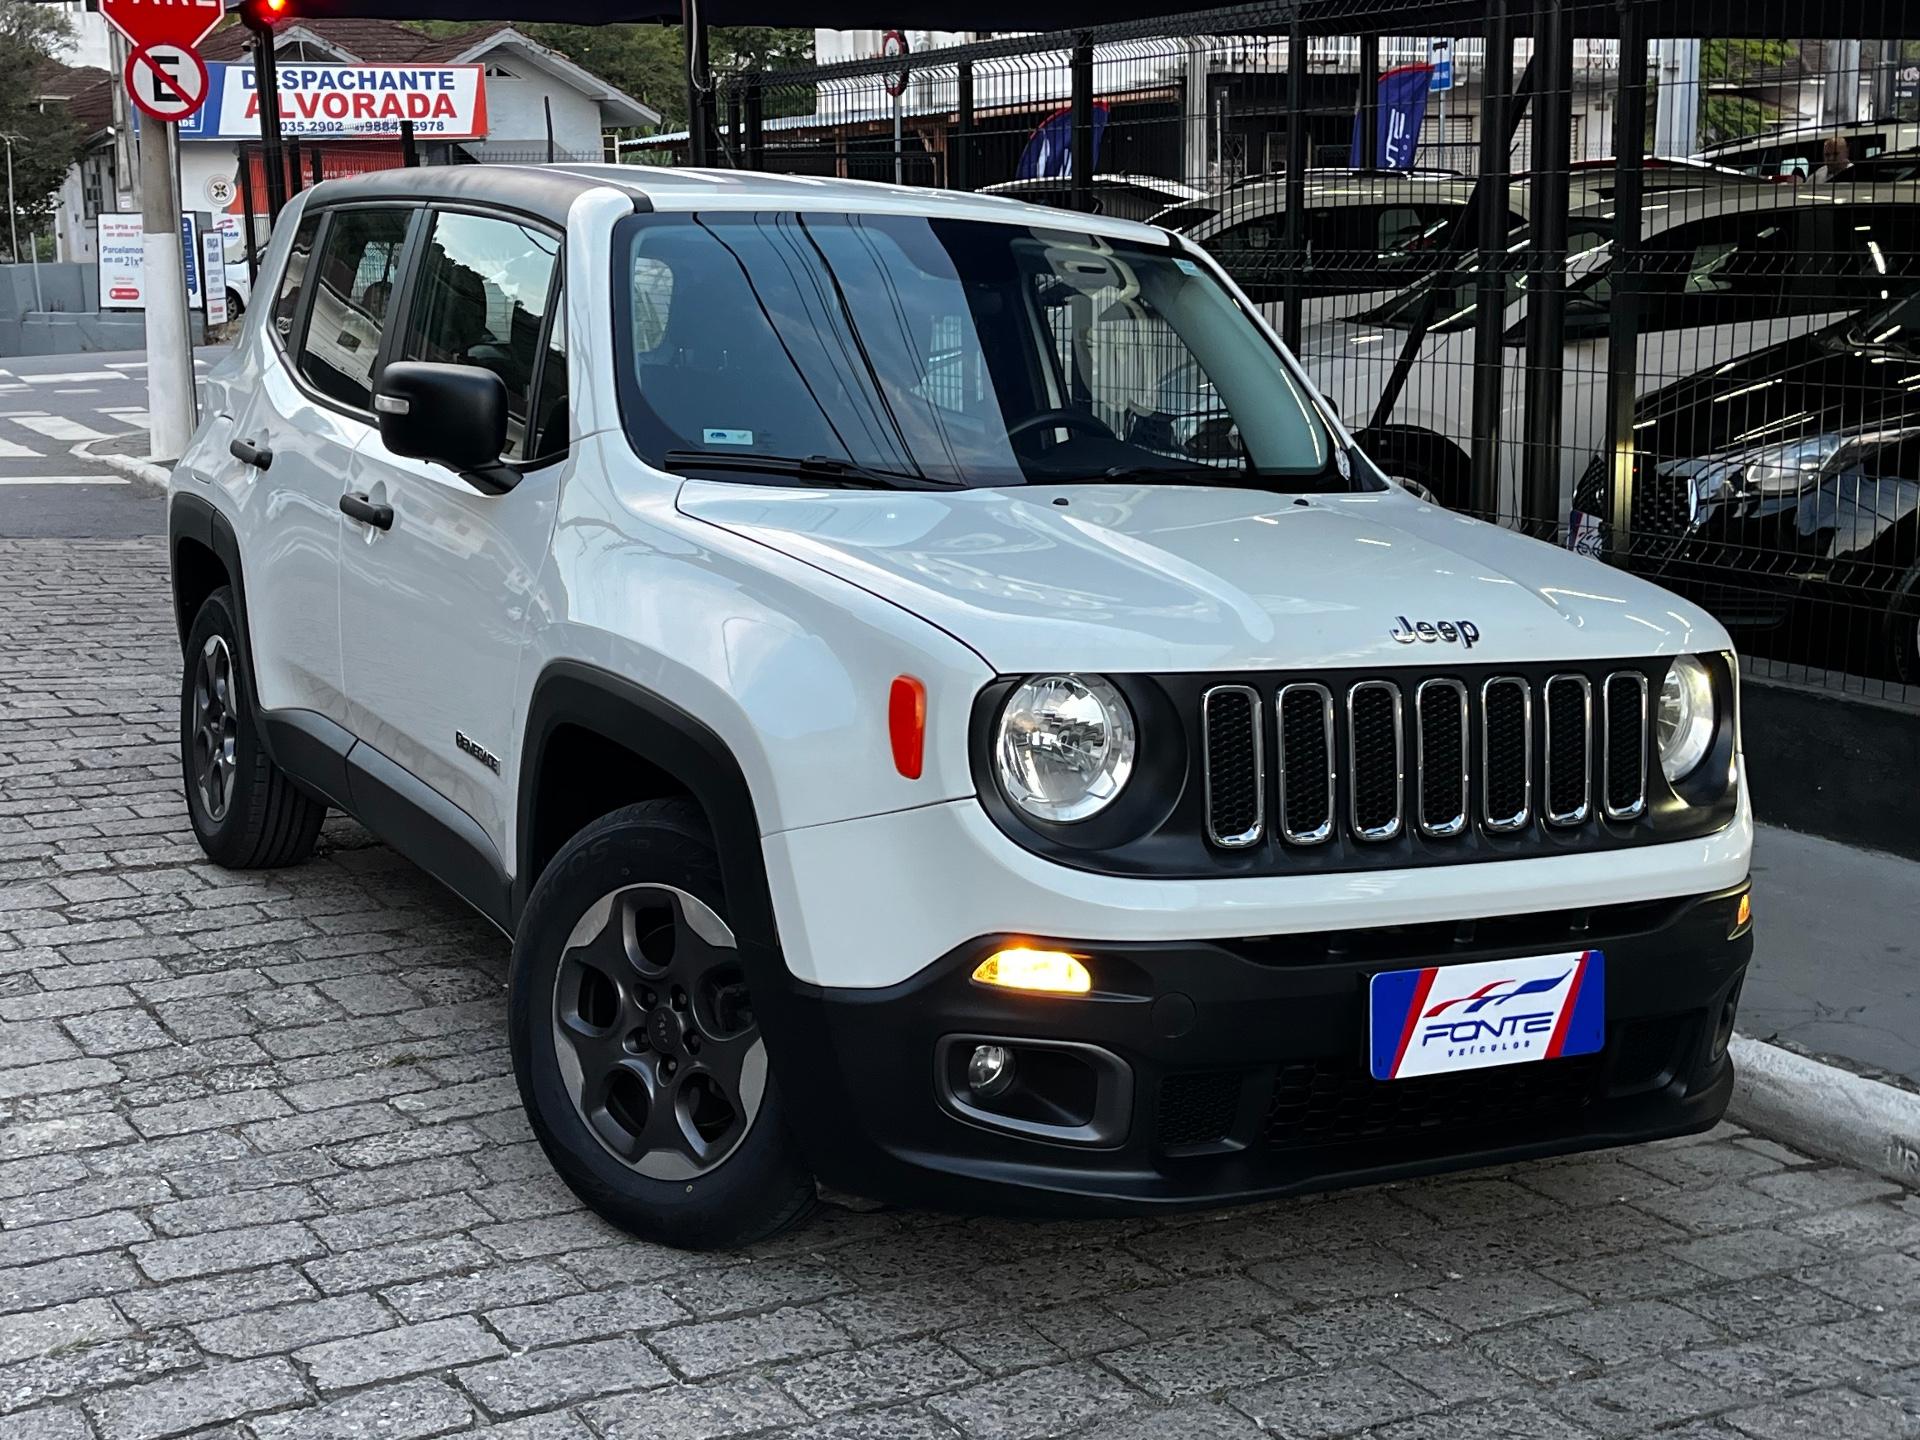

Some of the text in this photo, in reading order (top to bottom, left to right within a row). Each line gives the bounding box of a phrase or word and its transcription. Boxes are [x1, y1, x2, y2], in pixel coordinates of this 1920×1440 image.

[241, 69, 456, 91] DSPACHANTE
[279, 120, 343, 133] 035.2902
[103, 245, 144, 254] Parcelamos
[1389, 615, 1480, 650] Jeep
[1421, 1010, 1555, 1048] FONTE
[1447, 1039, 1532, 1059] VEÍCULOS
